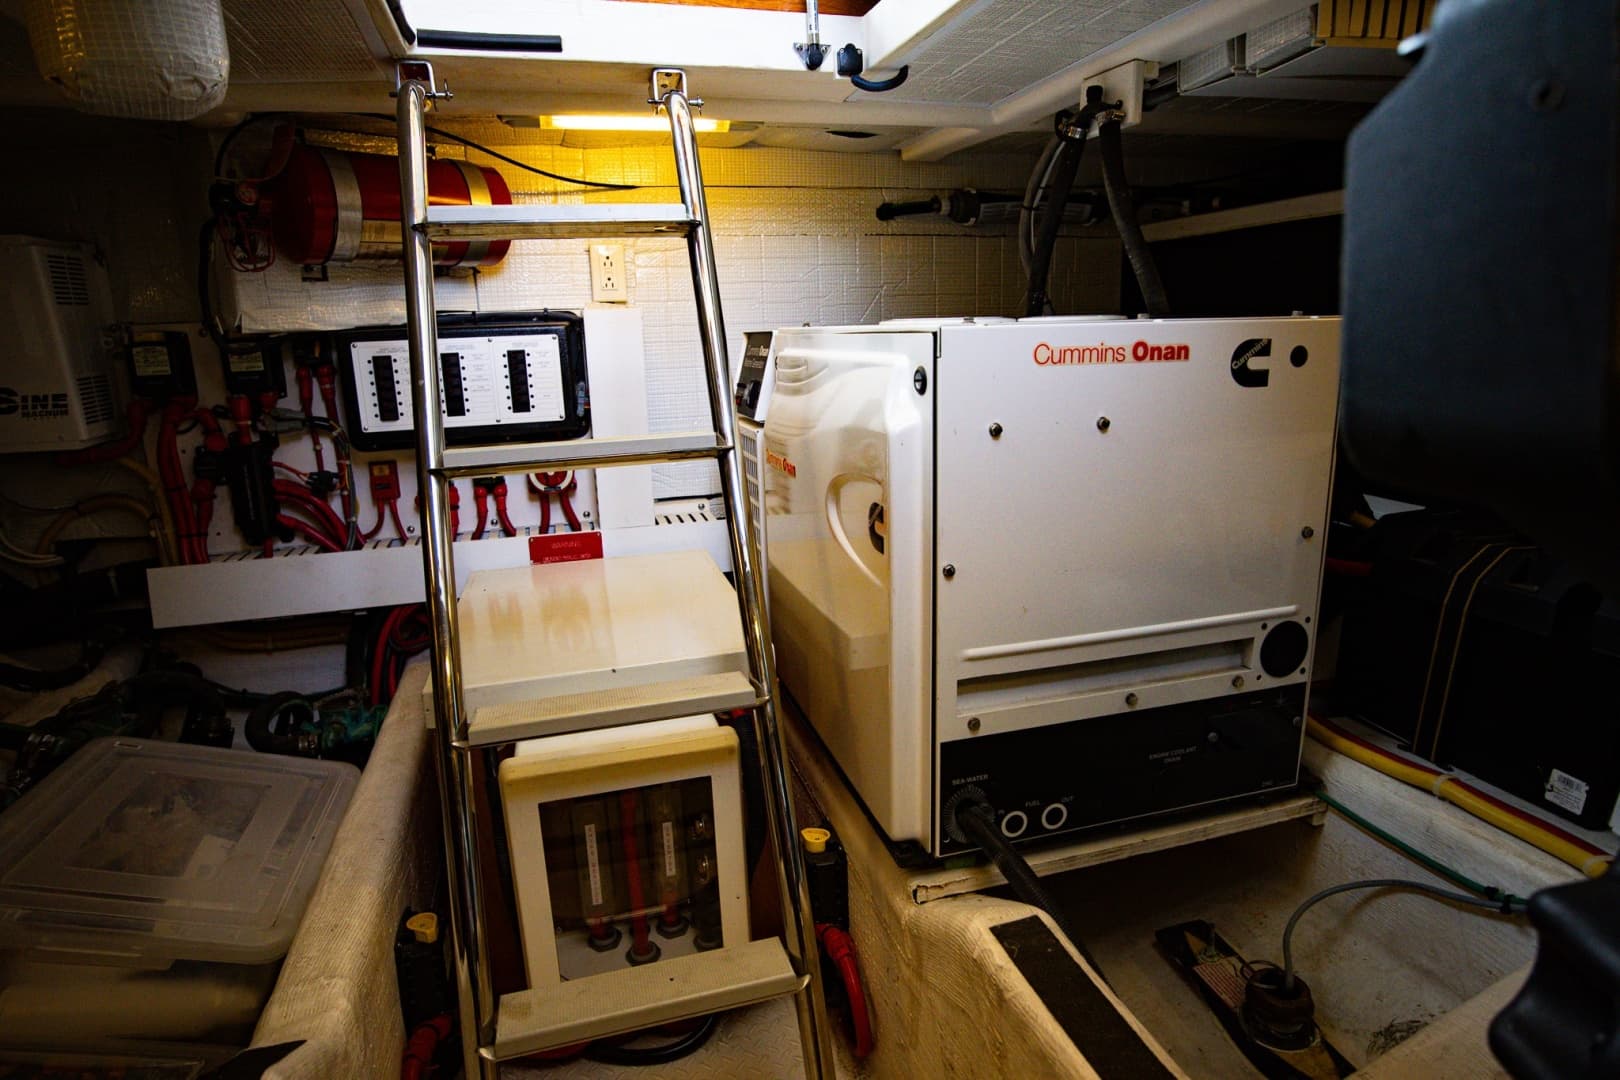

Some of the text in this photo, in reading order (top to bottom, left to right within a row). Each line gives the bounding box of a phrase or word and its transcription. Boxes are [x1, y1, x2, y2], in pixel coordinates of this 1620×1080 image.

[1033, 341, 1189, 365] Cummins Onan
[965, 773, 989, 782] WATER
